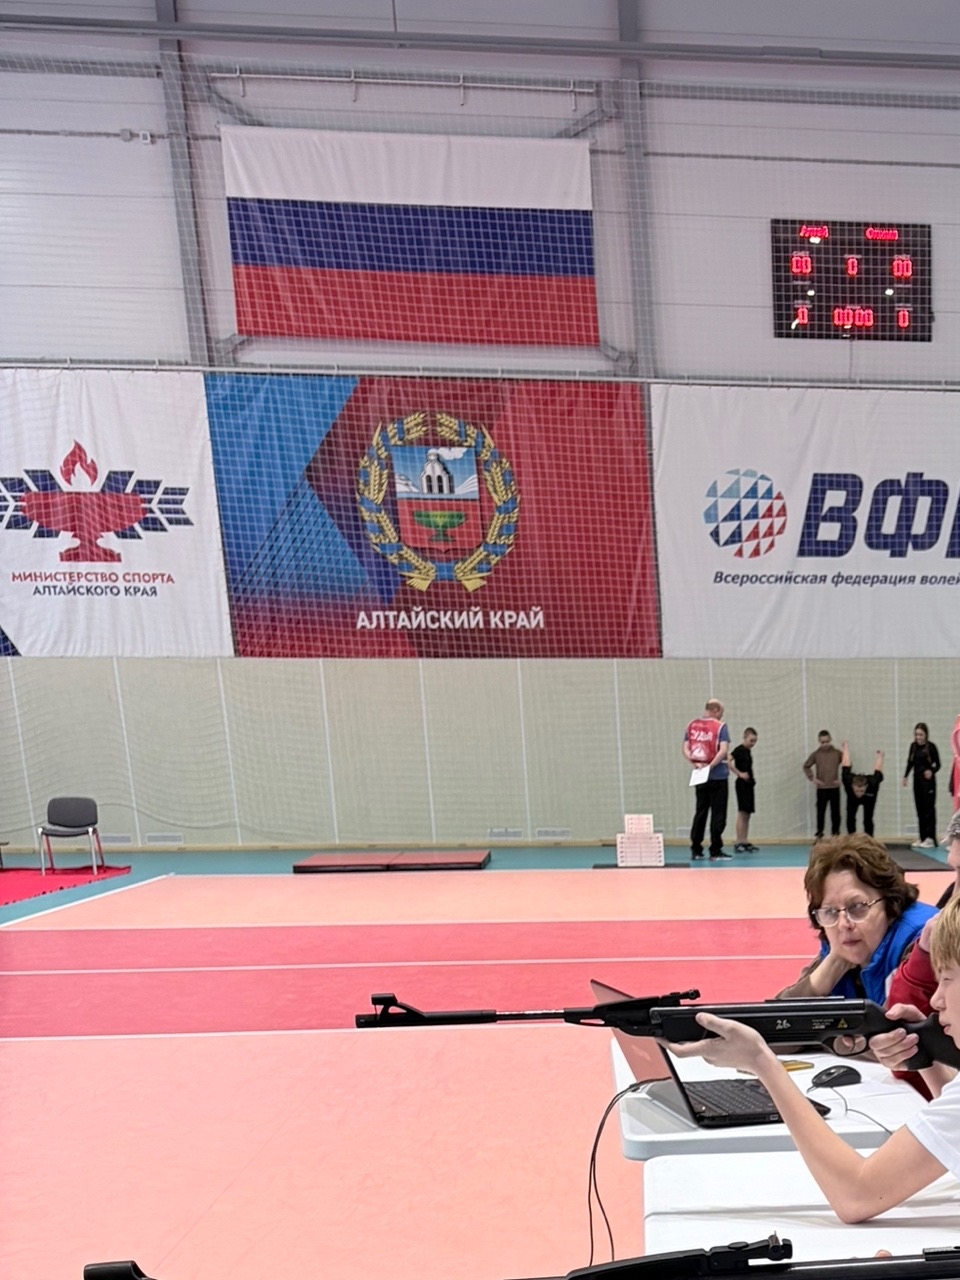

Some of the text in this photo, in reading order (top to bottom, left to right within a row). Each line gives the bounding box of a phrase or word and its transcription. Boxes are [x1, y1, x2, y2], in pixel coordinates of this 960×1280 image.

[11, 571, 175, 584] МИНИСТЕРСТВО СПОРТА
[713, 571, 827, 587] Всероссийская
[830, 572, 916, 587] федерация
[32, 582, 158, 597] АЛТАЙСКОГО КРАЯ
[356, 605, 545, 629] АЛТАЙСКИЙ КРАЙ
